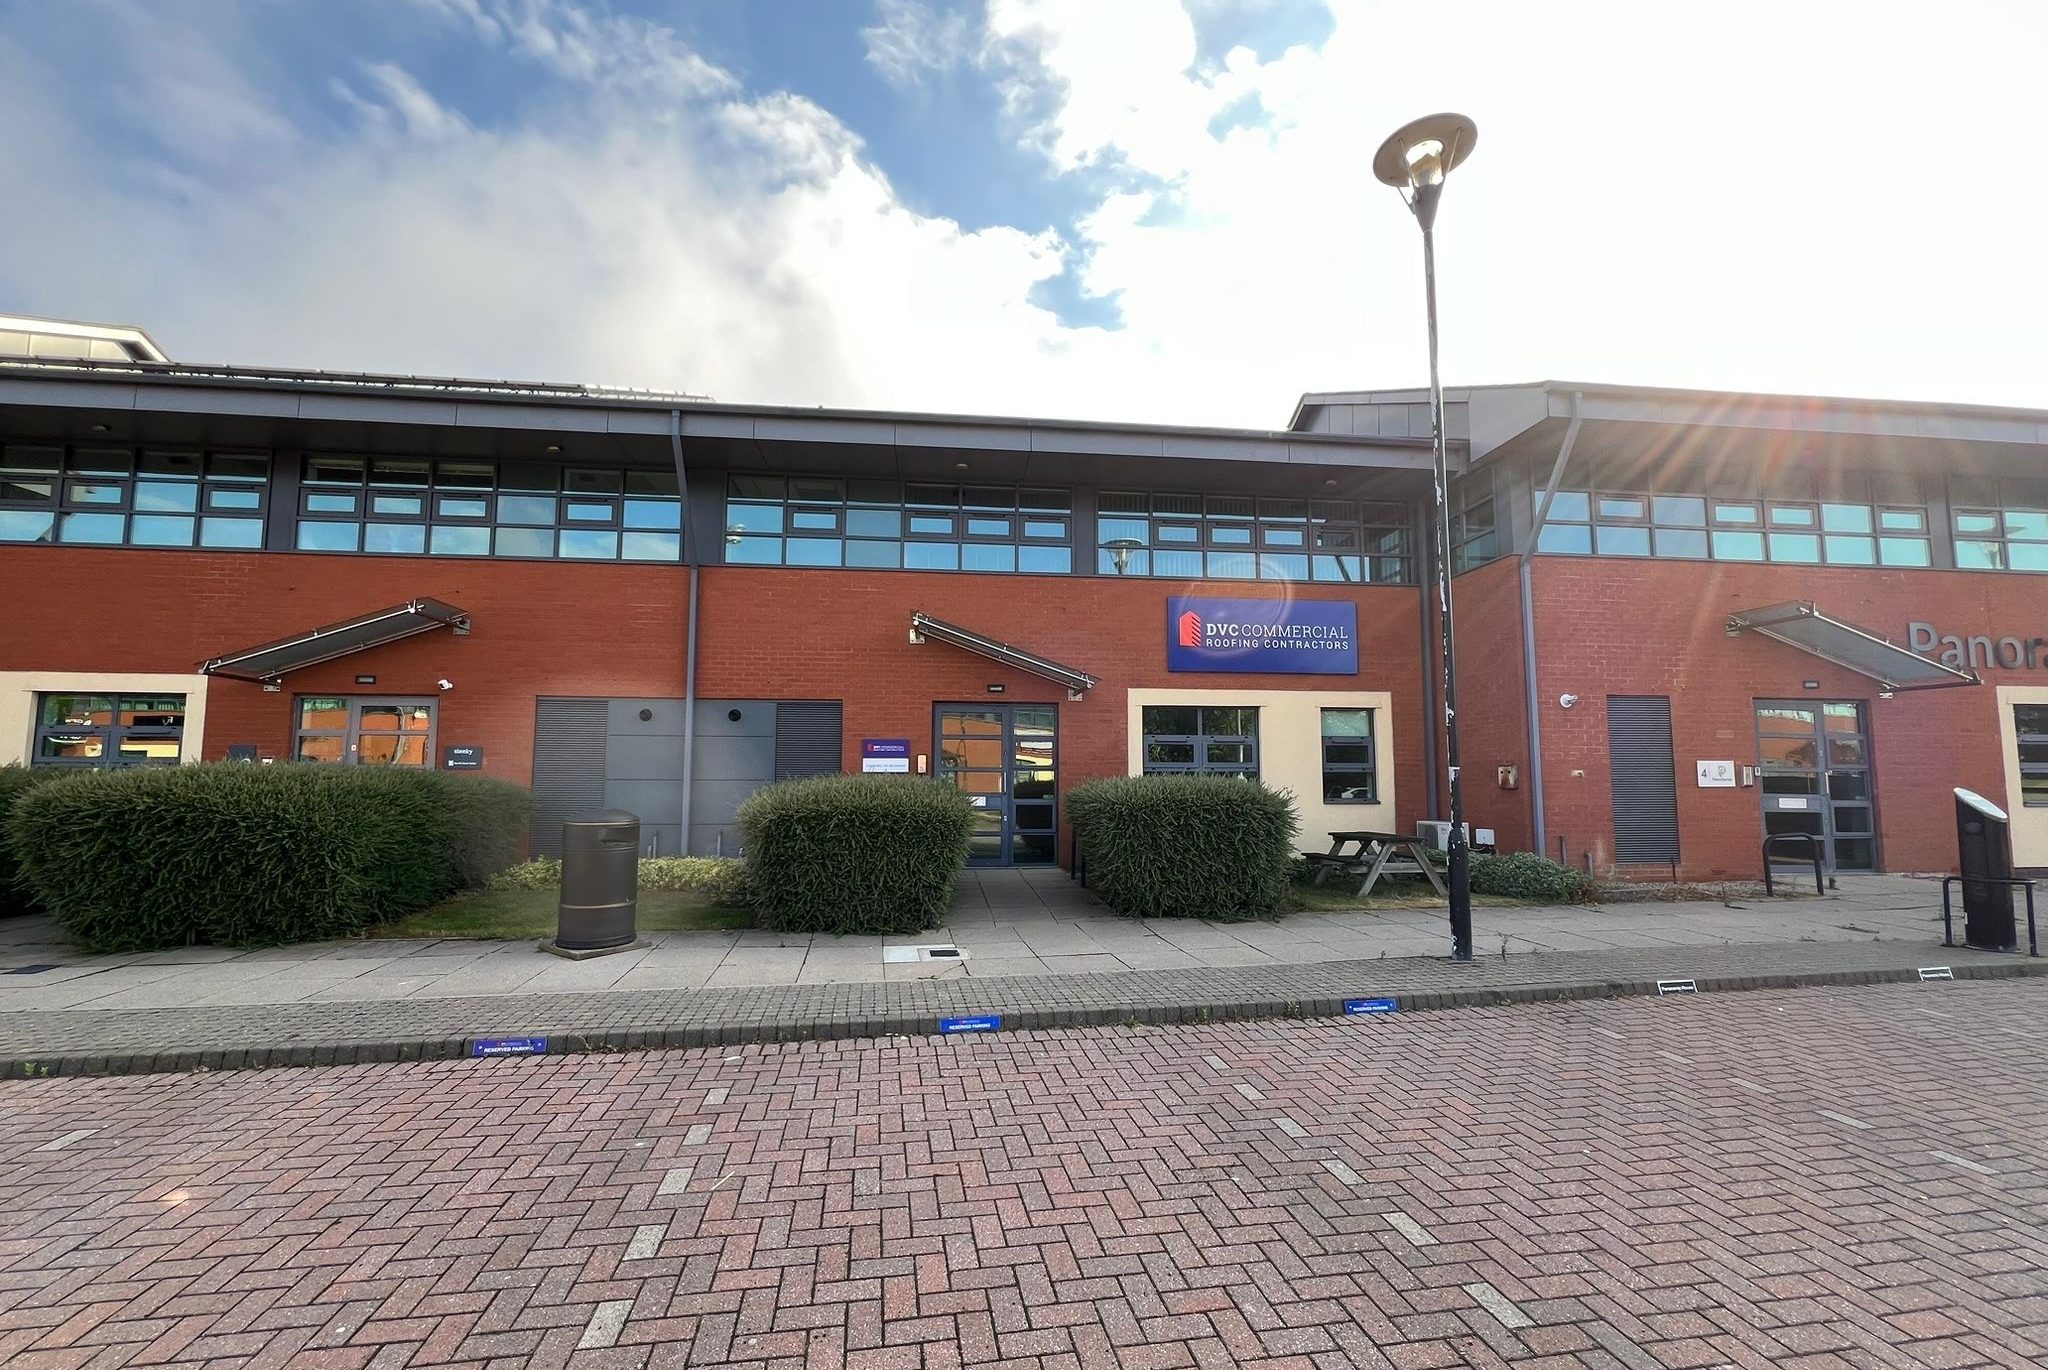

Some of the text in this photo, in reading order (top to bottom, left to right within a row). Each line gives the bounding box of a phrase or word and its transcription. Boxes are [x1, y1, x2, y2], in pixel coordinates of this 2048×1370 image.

[1206, 623, 1349, 639] DVC COMMERCIAL
[1206, 638, 1349, 650] ROOFING CONTRACTORS
[1908, 622, 2048, 669] Panor
[1701, 768, 1707, 778] 4
